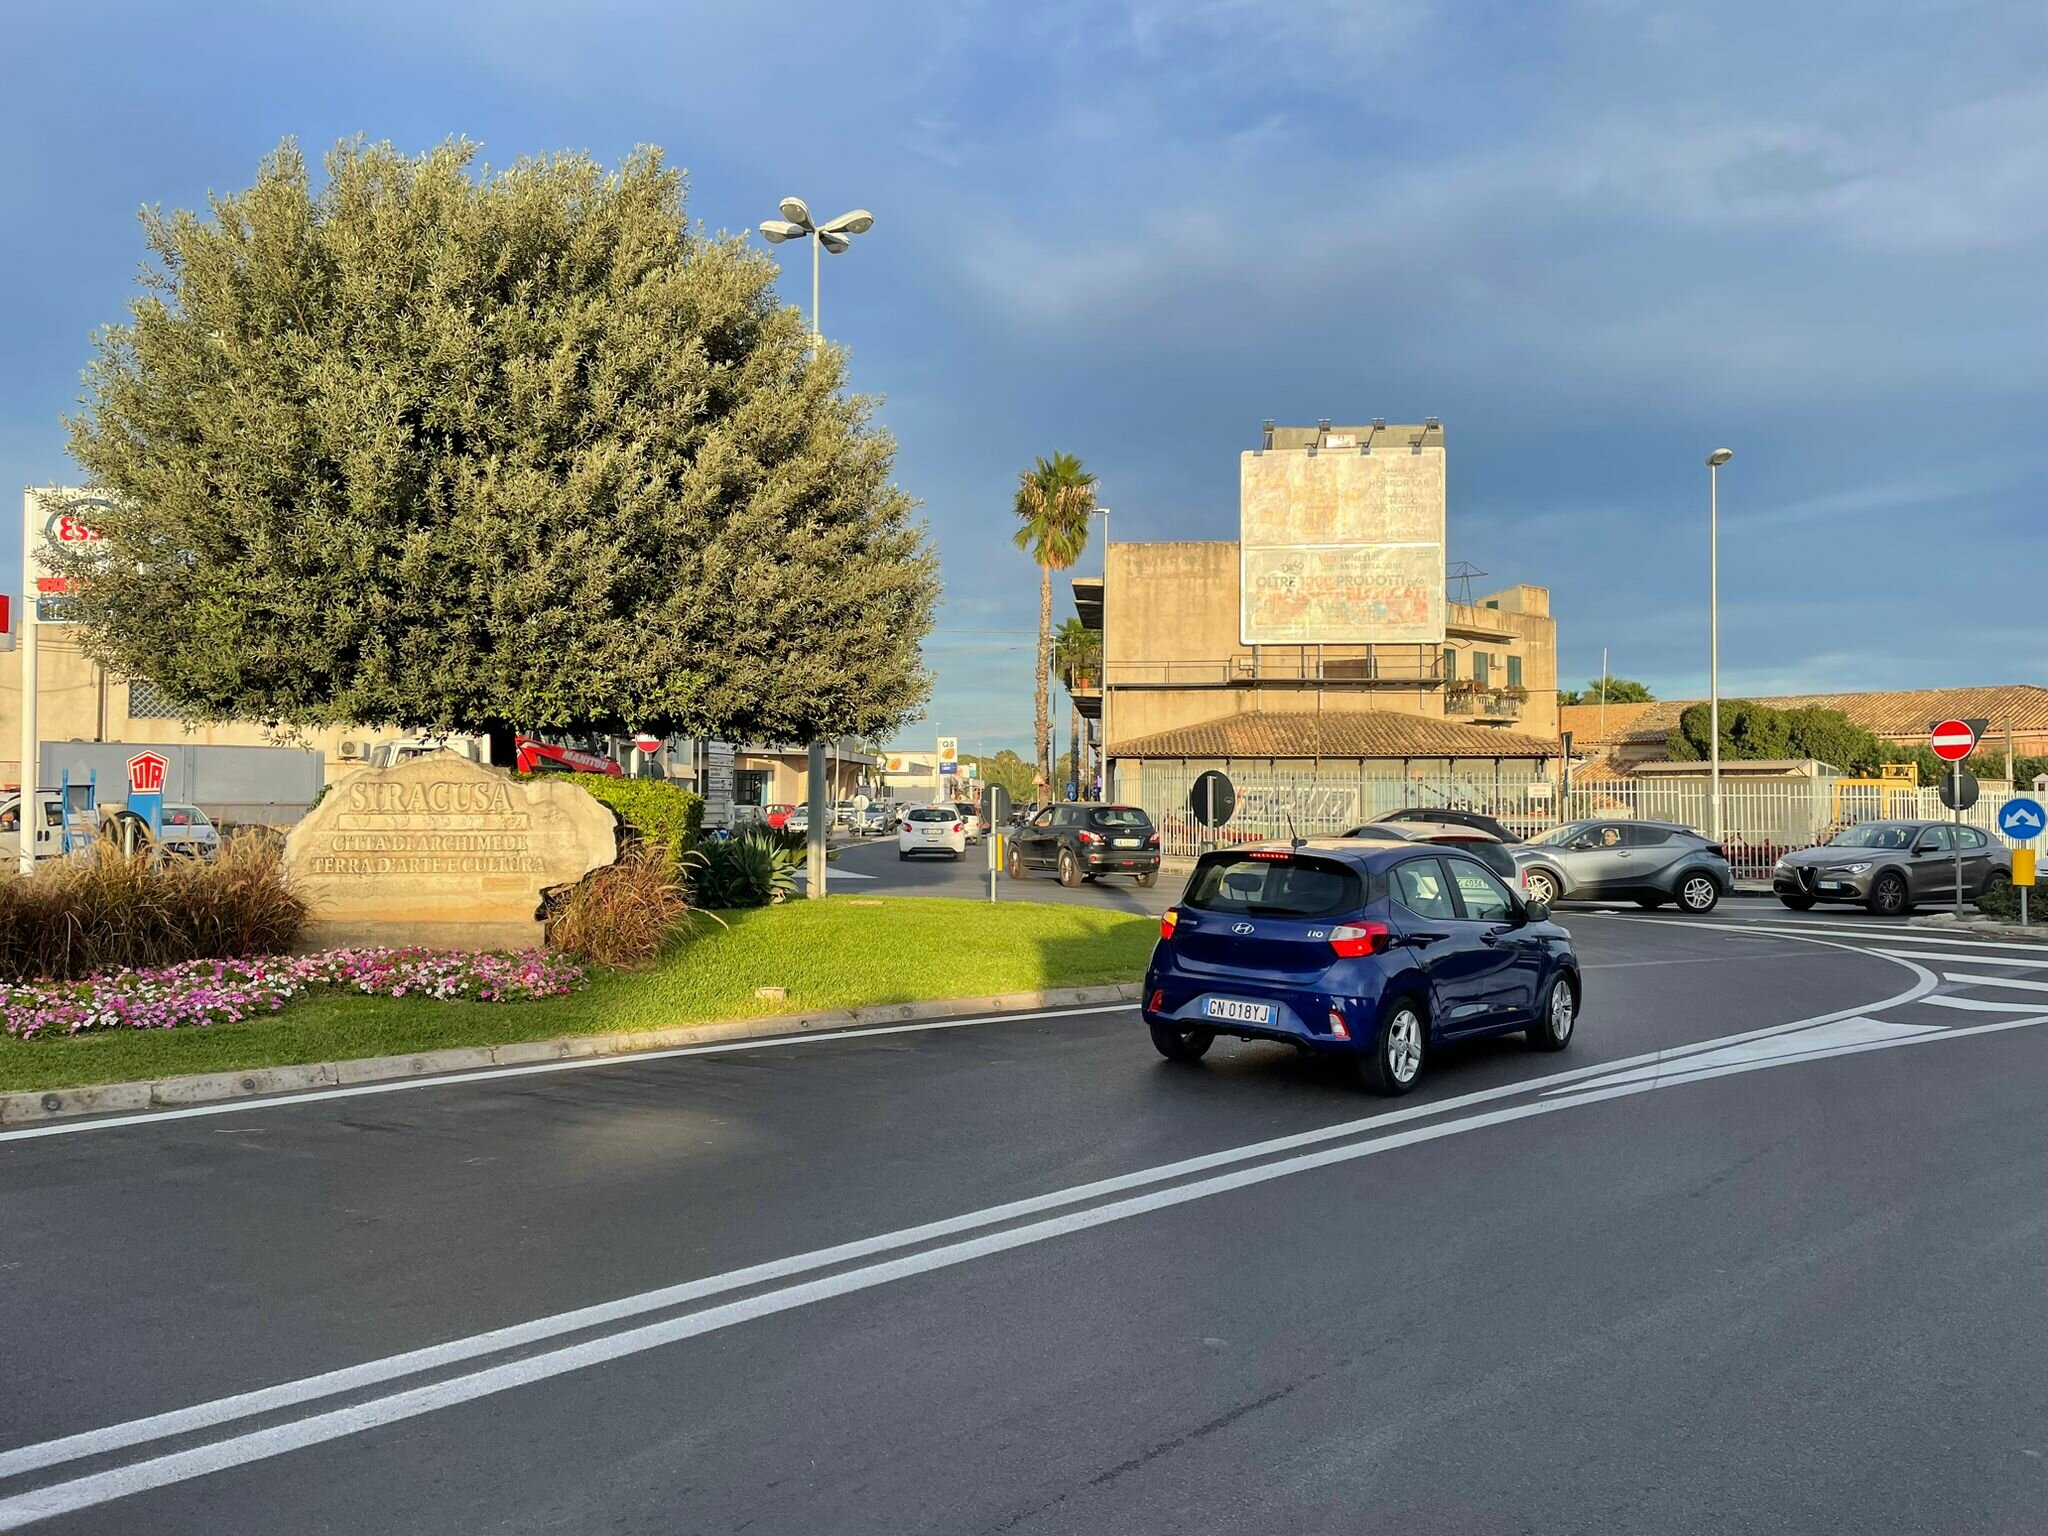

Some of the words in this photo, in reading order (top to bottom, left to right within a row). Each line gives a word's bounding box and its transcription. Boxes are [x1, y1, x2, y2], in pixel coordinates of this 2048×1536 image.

[60, 515, 106, 541] Es
[1256, 576, 1296, 588] OLTRE
[1336, 574, 1405, 587] PRODOTTI
[942, 740, 954, 748] Q8
[562, 750, 609, 770] MANITOU
[350, 781, 514, 812] SIRACUSA
[392, 835, 412, 852] DI
[416, 834, 529, 852] ARCHIMEDE
[311, 856, 374, 874] TERRA
[376, 856, 441, 874] D'ARTE
[447, 857, 458, 873] E
[461, 857, 547, 874] CULTURA
[1209, 1000, 1225, 1016] GN
[1228, 1003, 1268, 1022] 018YJ
